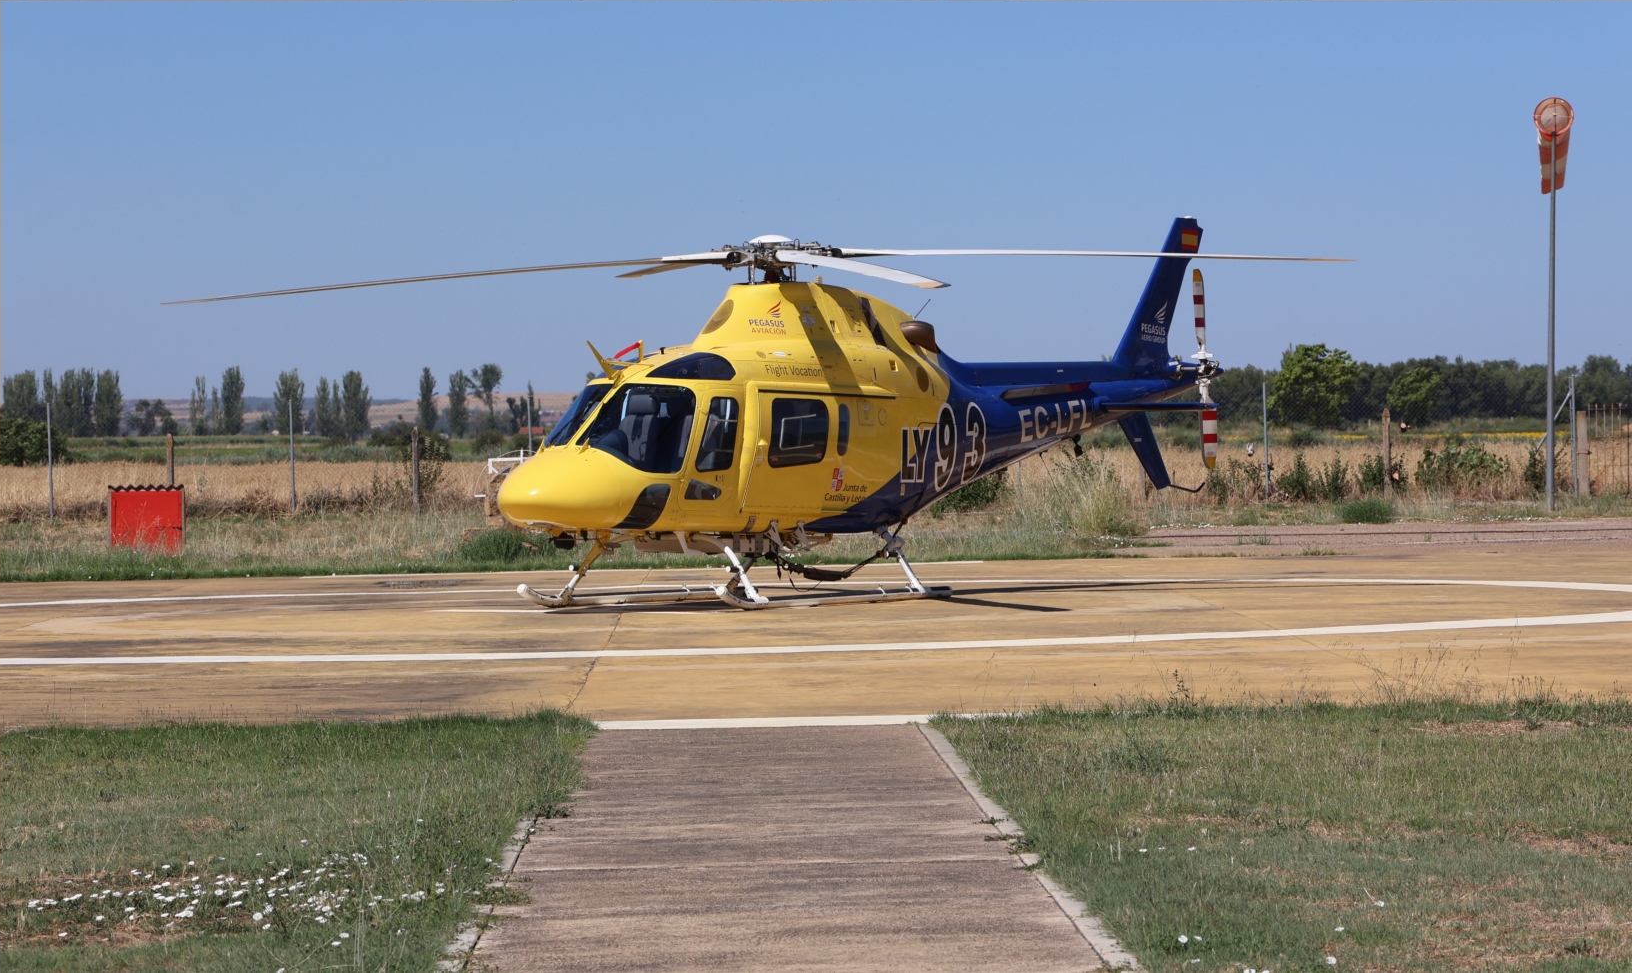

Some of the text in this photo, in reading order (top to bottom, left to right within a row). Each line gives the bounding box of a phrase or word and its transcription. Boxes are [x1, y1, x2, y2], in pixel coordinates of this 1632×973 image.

[749, 318, 785, 328] PEGASUS
[1141, 323, 1166, 336] PEGASUS
[1141, 334, 1166, 344] AERO GROUP
[765, 364, 823, 377] Flight Vocation
[1018, 398, 1093, 443] EC-LFL
[842, 484, 867, 493] Junta de
[824, 493, 845, 502] Castilla
